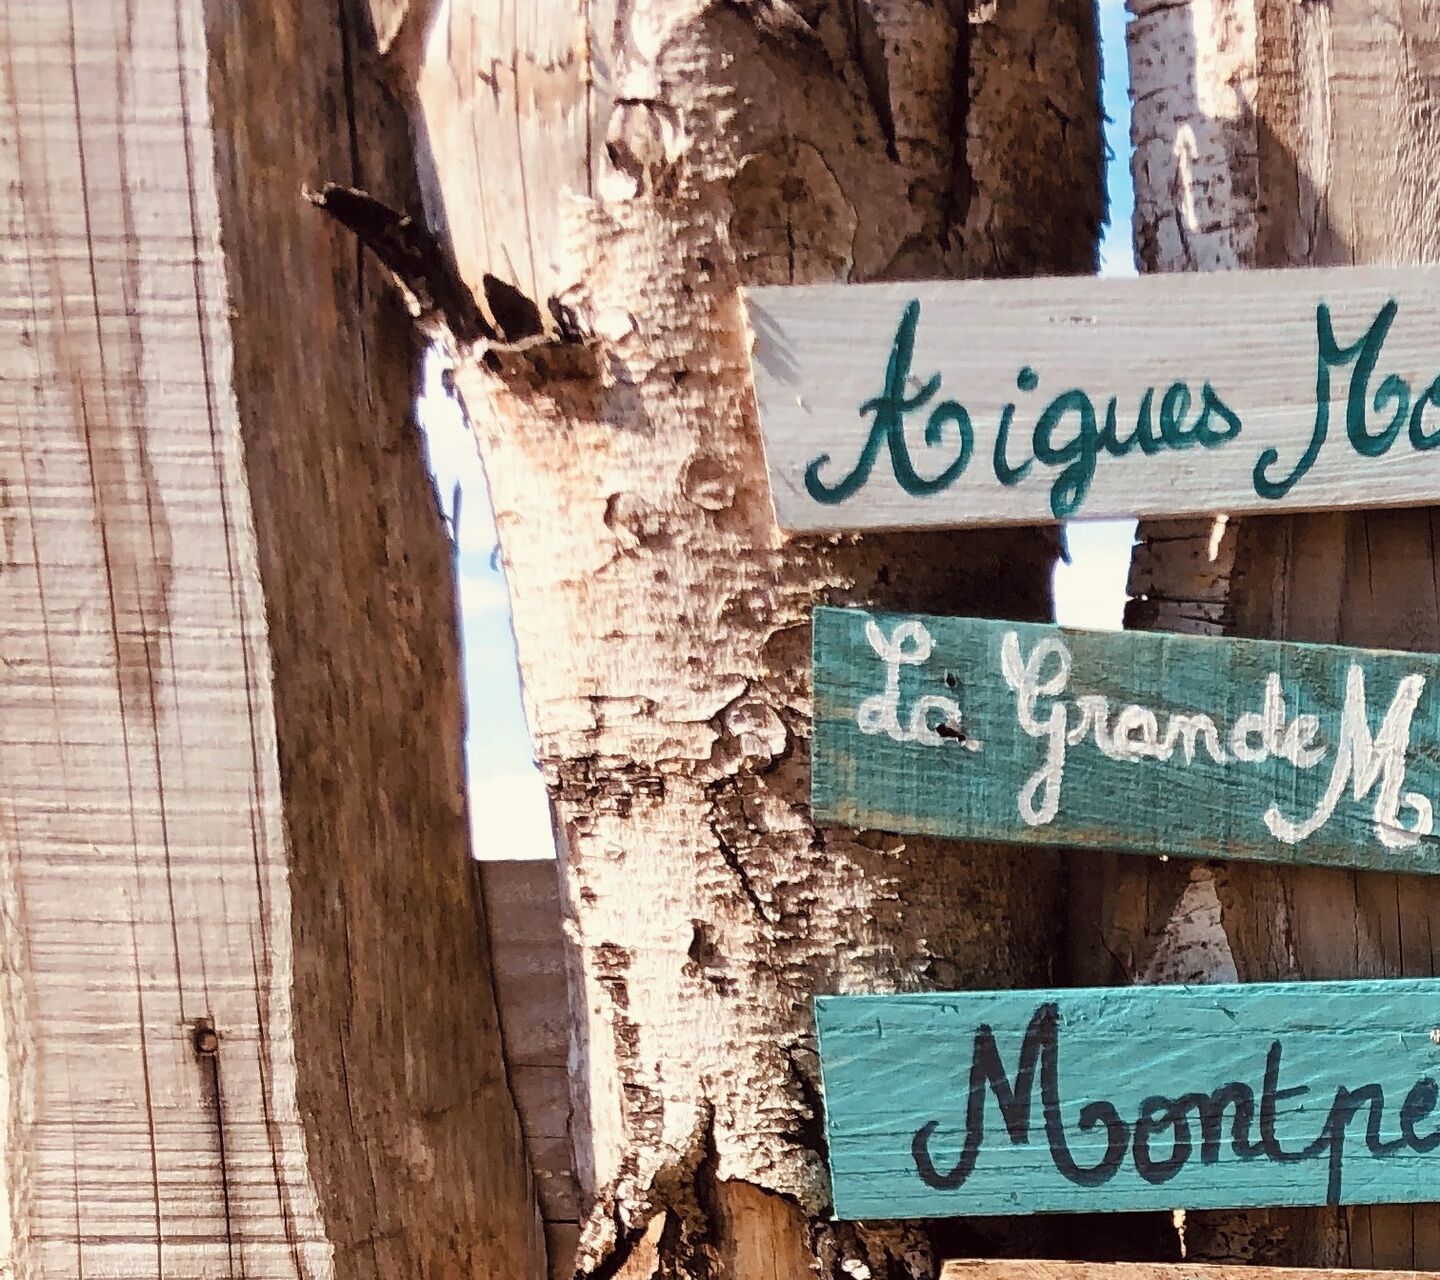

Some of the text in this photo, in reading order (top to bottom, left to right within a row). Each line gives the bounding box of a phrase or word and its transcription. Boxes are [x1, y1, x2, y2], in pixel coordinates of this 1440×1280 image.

[805, 299, 1242, 518] Aigues
[857, 620, 982, 746] La
[1001, 631, 1326, 826] Grande
